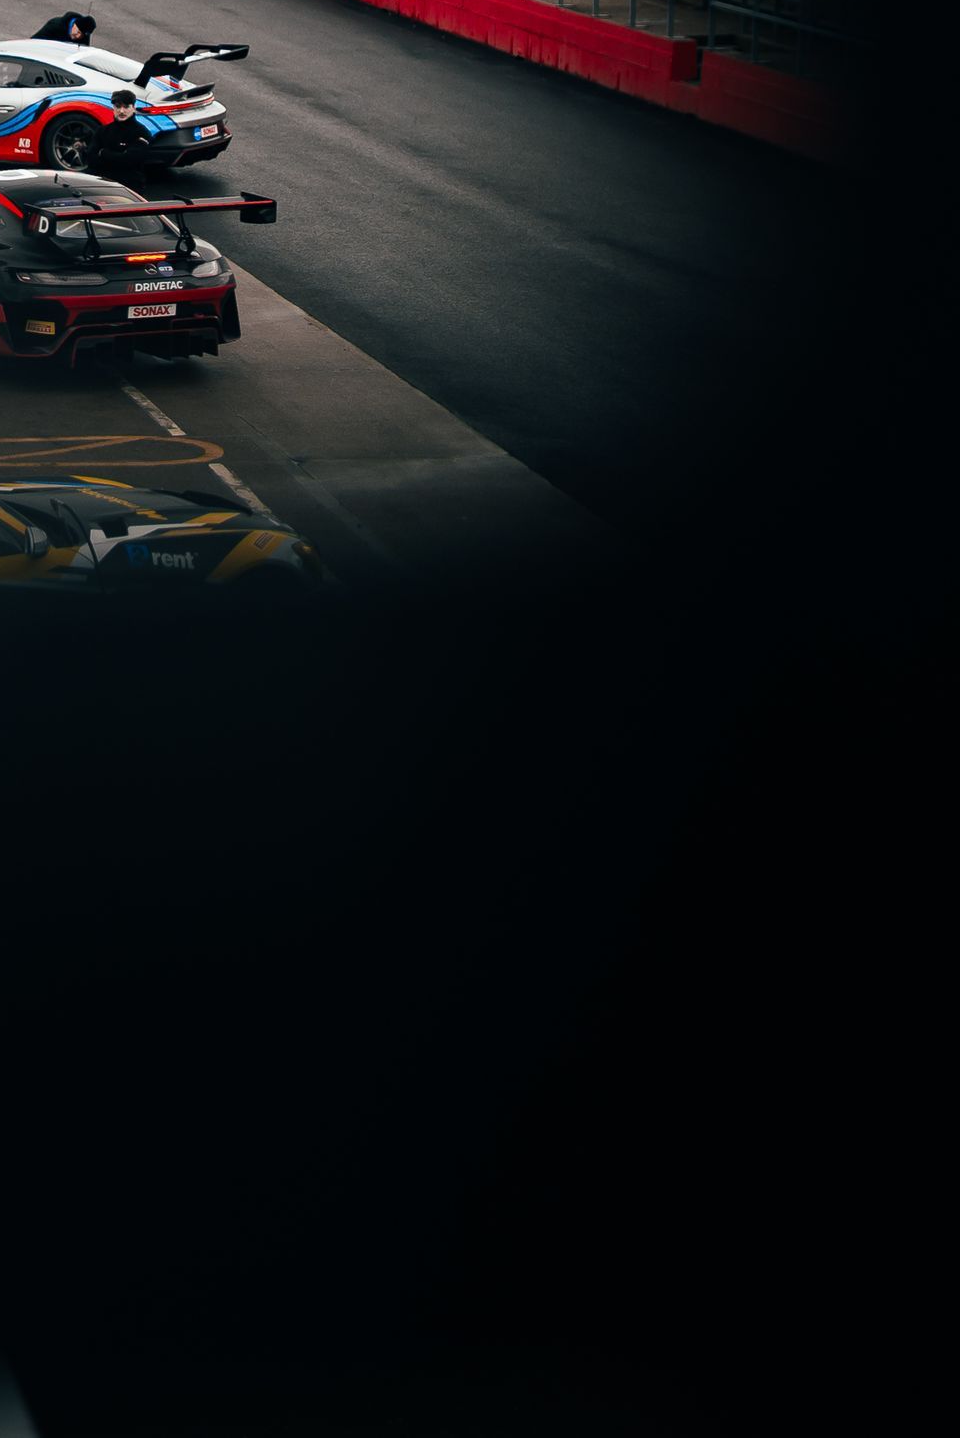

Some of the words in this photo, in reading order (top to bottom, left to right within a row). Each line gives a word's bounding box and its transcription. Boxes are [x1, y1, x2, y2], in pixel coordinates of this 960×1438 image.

[134, 280, 184, 292] DRIVETAC
[133, 305, 171, 317] SONAX
[151, 551, 195, 570] rent
